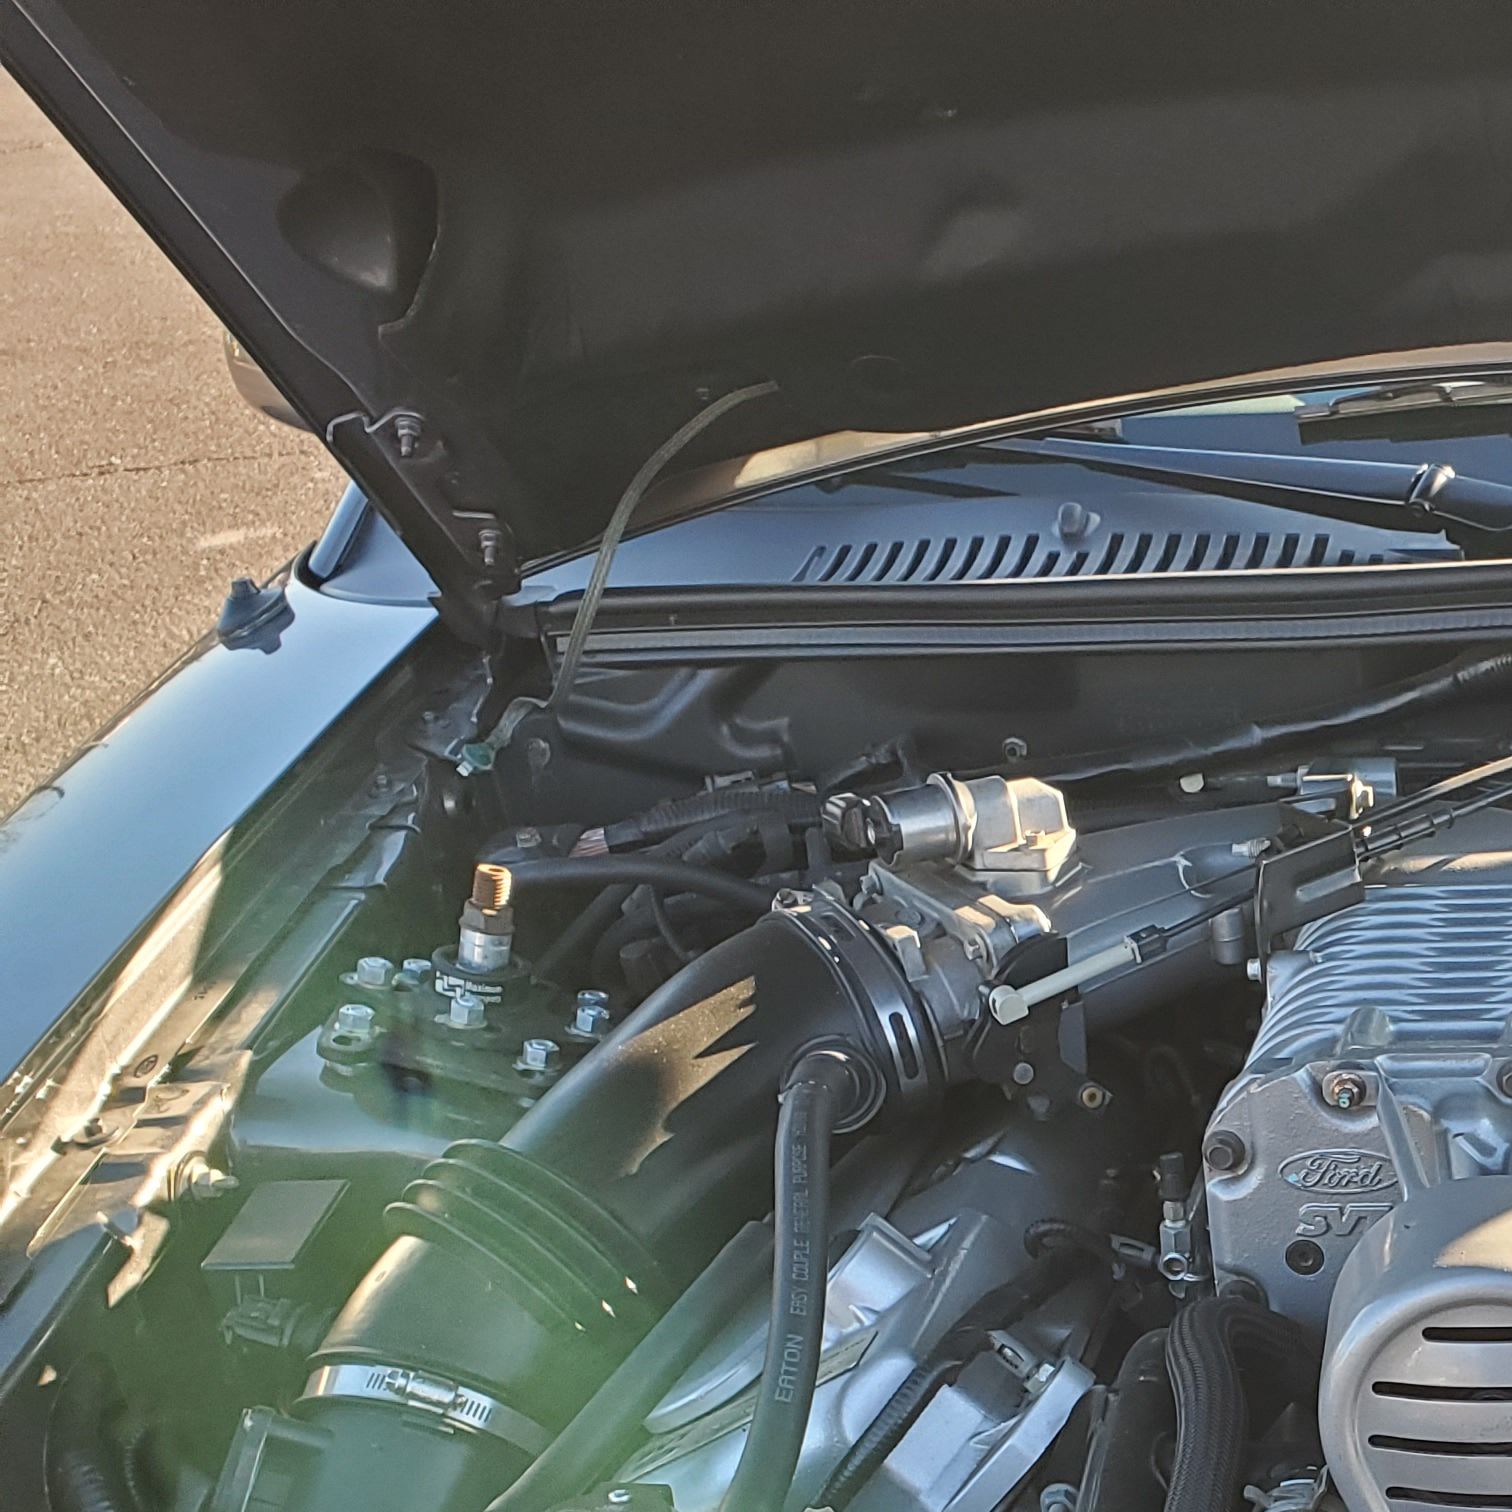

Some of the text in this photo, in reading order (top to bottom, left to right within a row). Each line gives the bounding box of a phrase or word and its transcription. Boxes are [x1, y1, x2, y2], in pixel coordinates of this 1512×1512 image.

[1300, 1153, 1383, 1188] Ford
[1295, 1202, 1394, 1238] SVT
[791, 1239, 811, 1281] COUPLE
[789, 1288, 808, 1316] EASY
[774, 1333, 804, 1403] EATON
